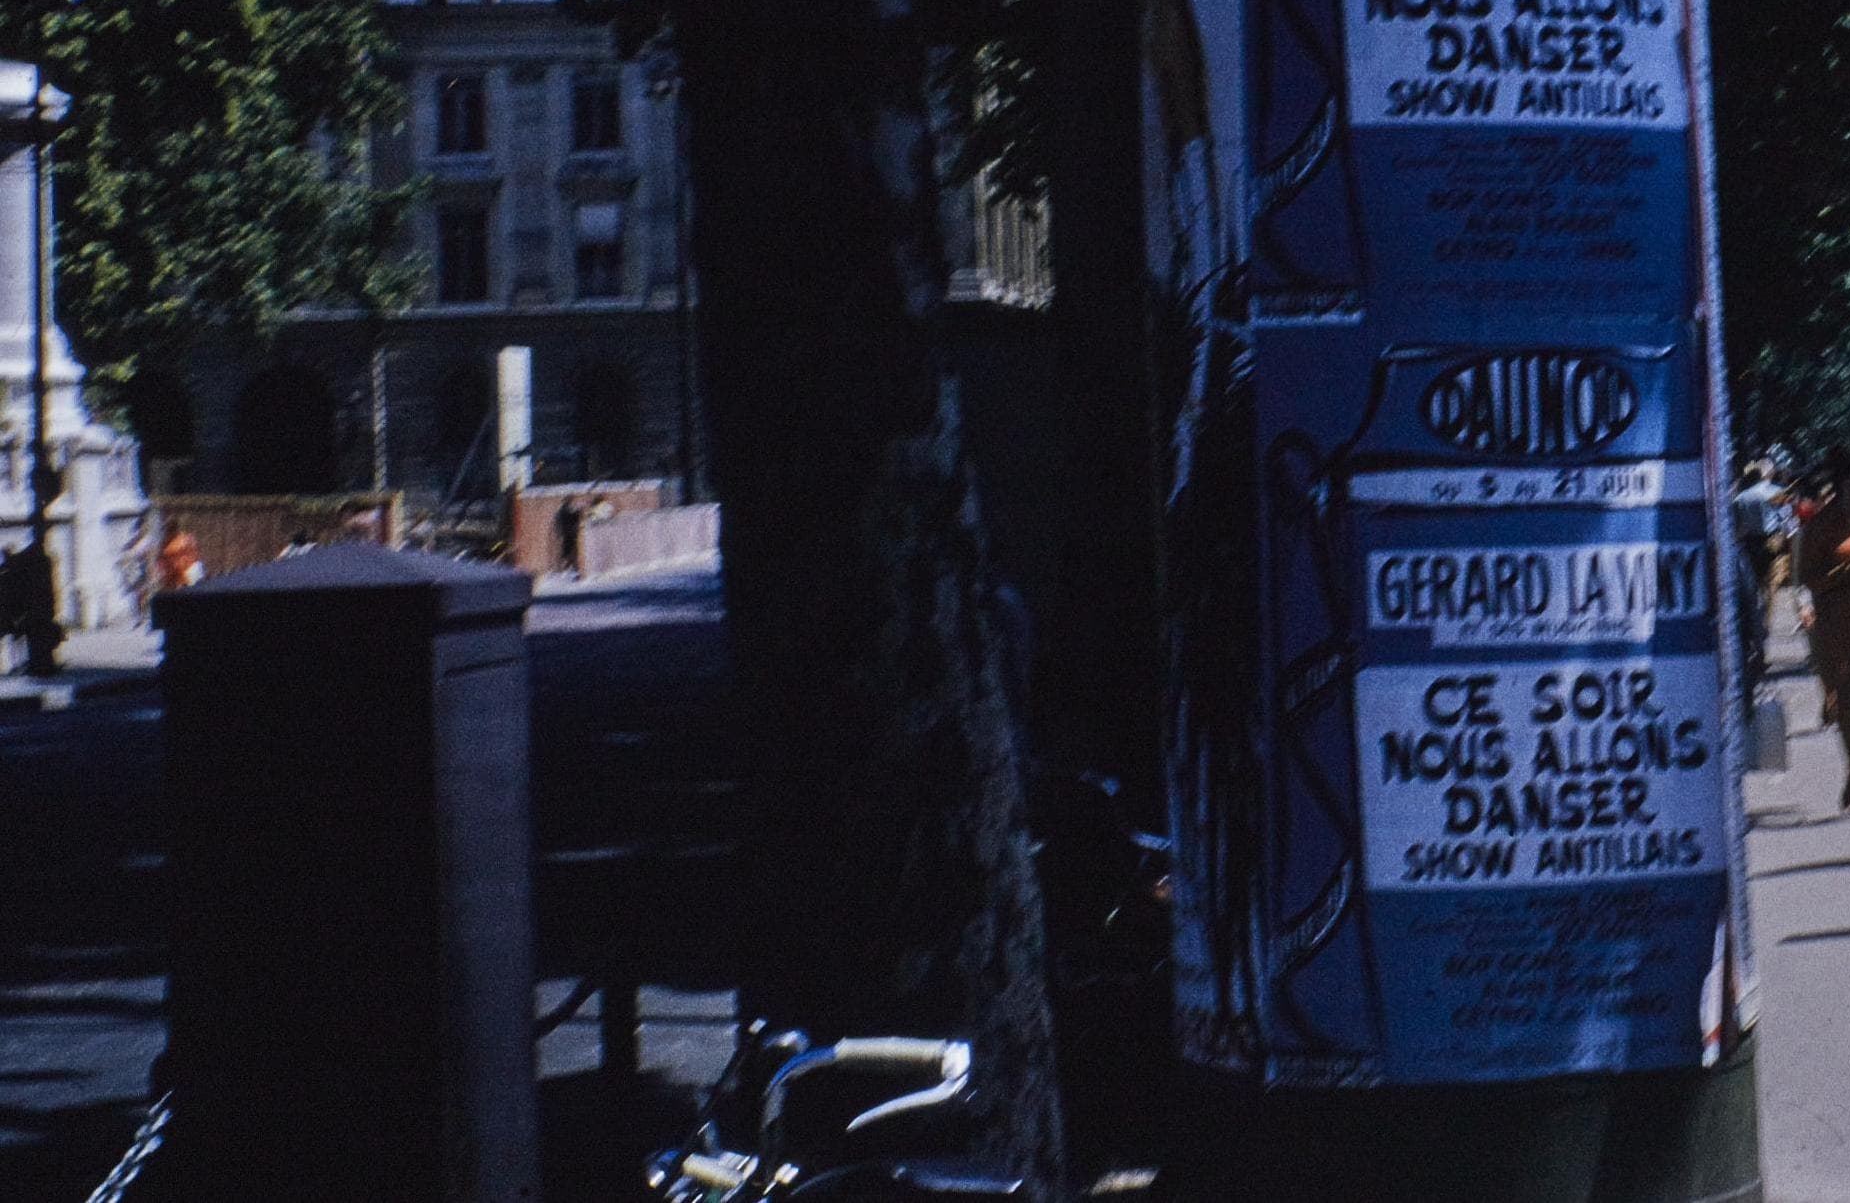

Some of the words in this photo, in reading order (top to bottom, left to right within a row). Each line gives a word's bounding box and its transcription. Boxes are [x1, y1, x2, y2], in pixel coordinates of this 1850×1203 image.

[1426, 23, 1633, 75] DANSER
[1383, 79, 1499, 118] SHOW
[1514, 81, 1665, 120] ANTILLAIS
[1377, 554, 1549, 620] GERARD
[1423, 671, 1500, 728] CE
[1530, 668, 1664, 724] SOIR
[1380, 730, 1511, 784] NOUS
[1533, 718, 1707, 774] ALLONS
[1443, 778, 1657, 838] DANSER
[1401, 836, 1518, 880] SHOW
[1532, 828, 1704, 876] ANTILLAIS
